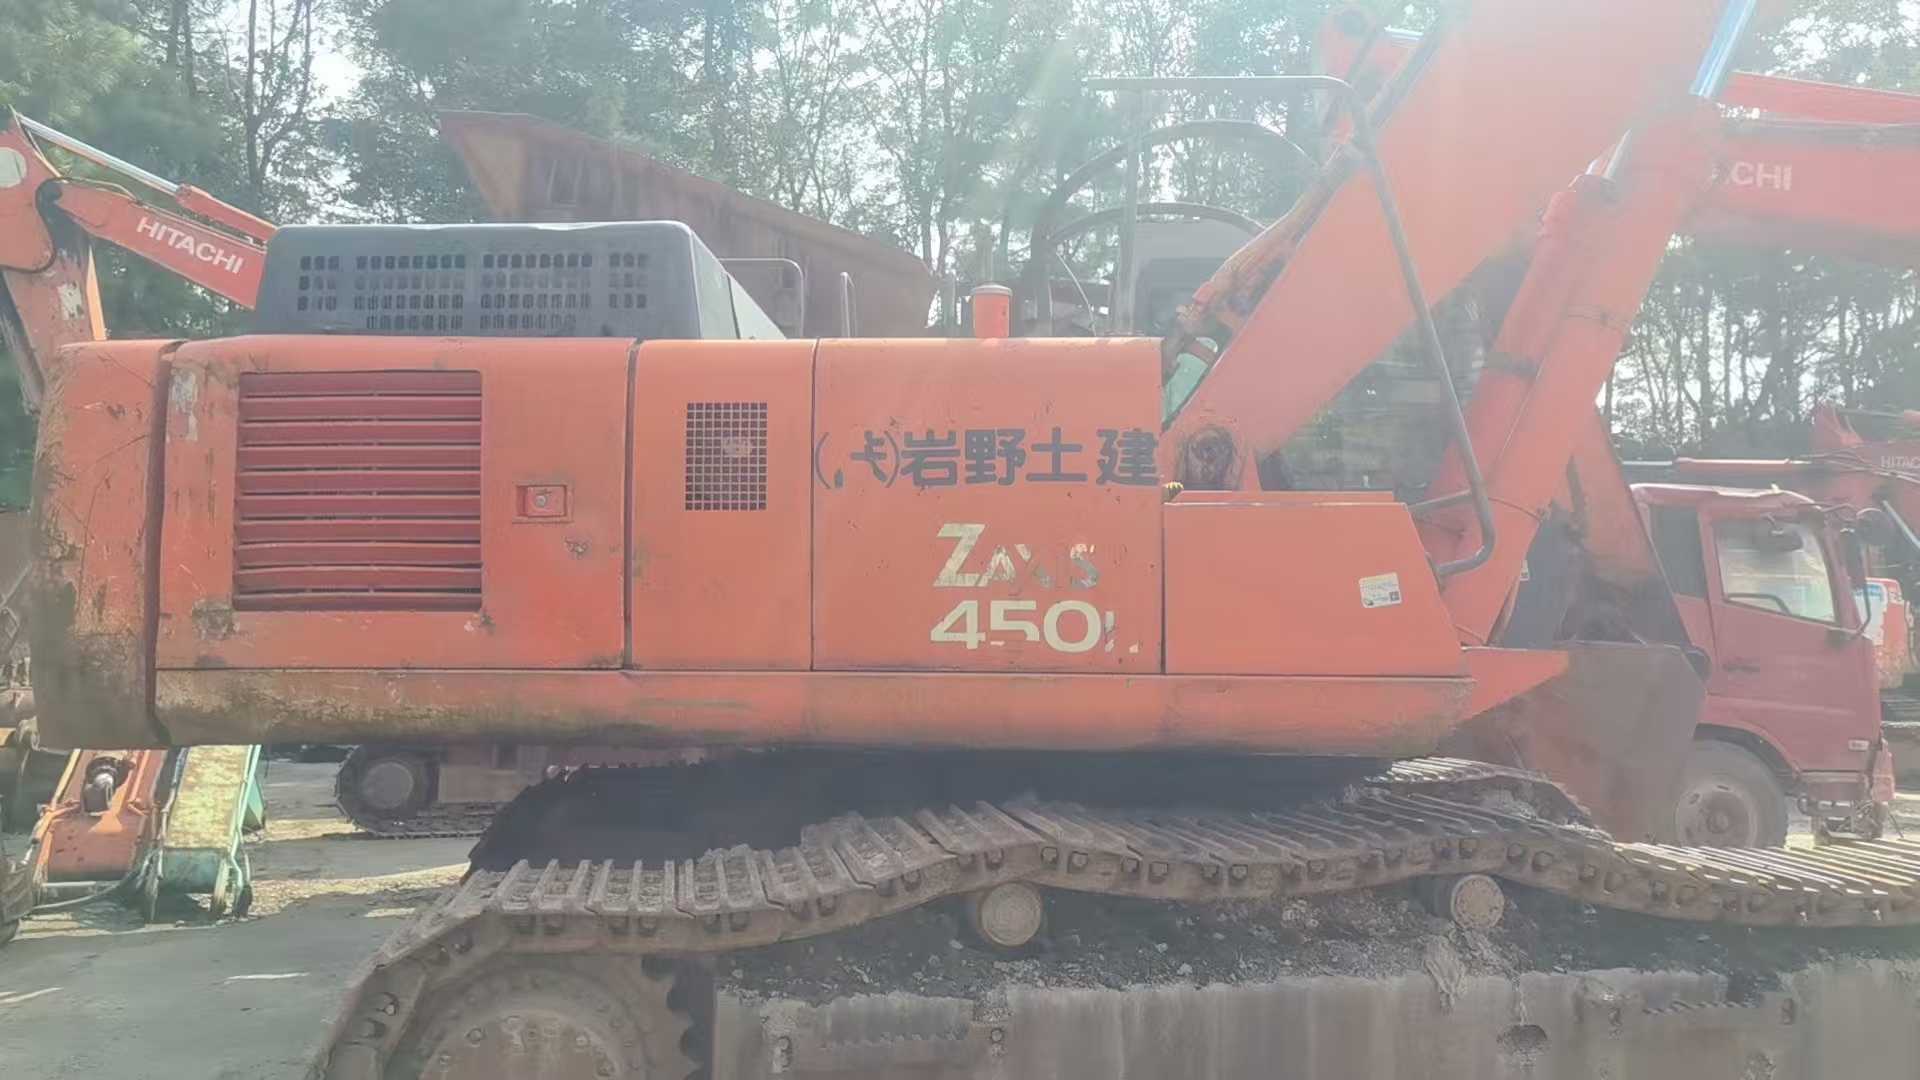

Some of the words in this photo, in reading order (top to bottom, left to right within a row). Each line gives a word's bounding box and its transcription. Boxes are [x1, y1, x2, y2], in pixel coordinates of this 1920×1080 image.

[1711, 161, 1792, 191] CHI
[136, 216, 244, 274] HITACHI
[933, 523, 1098, 588] ZAS
